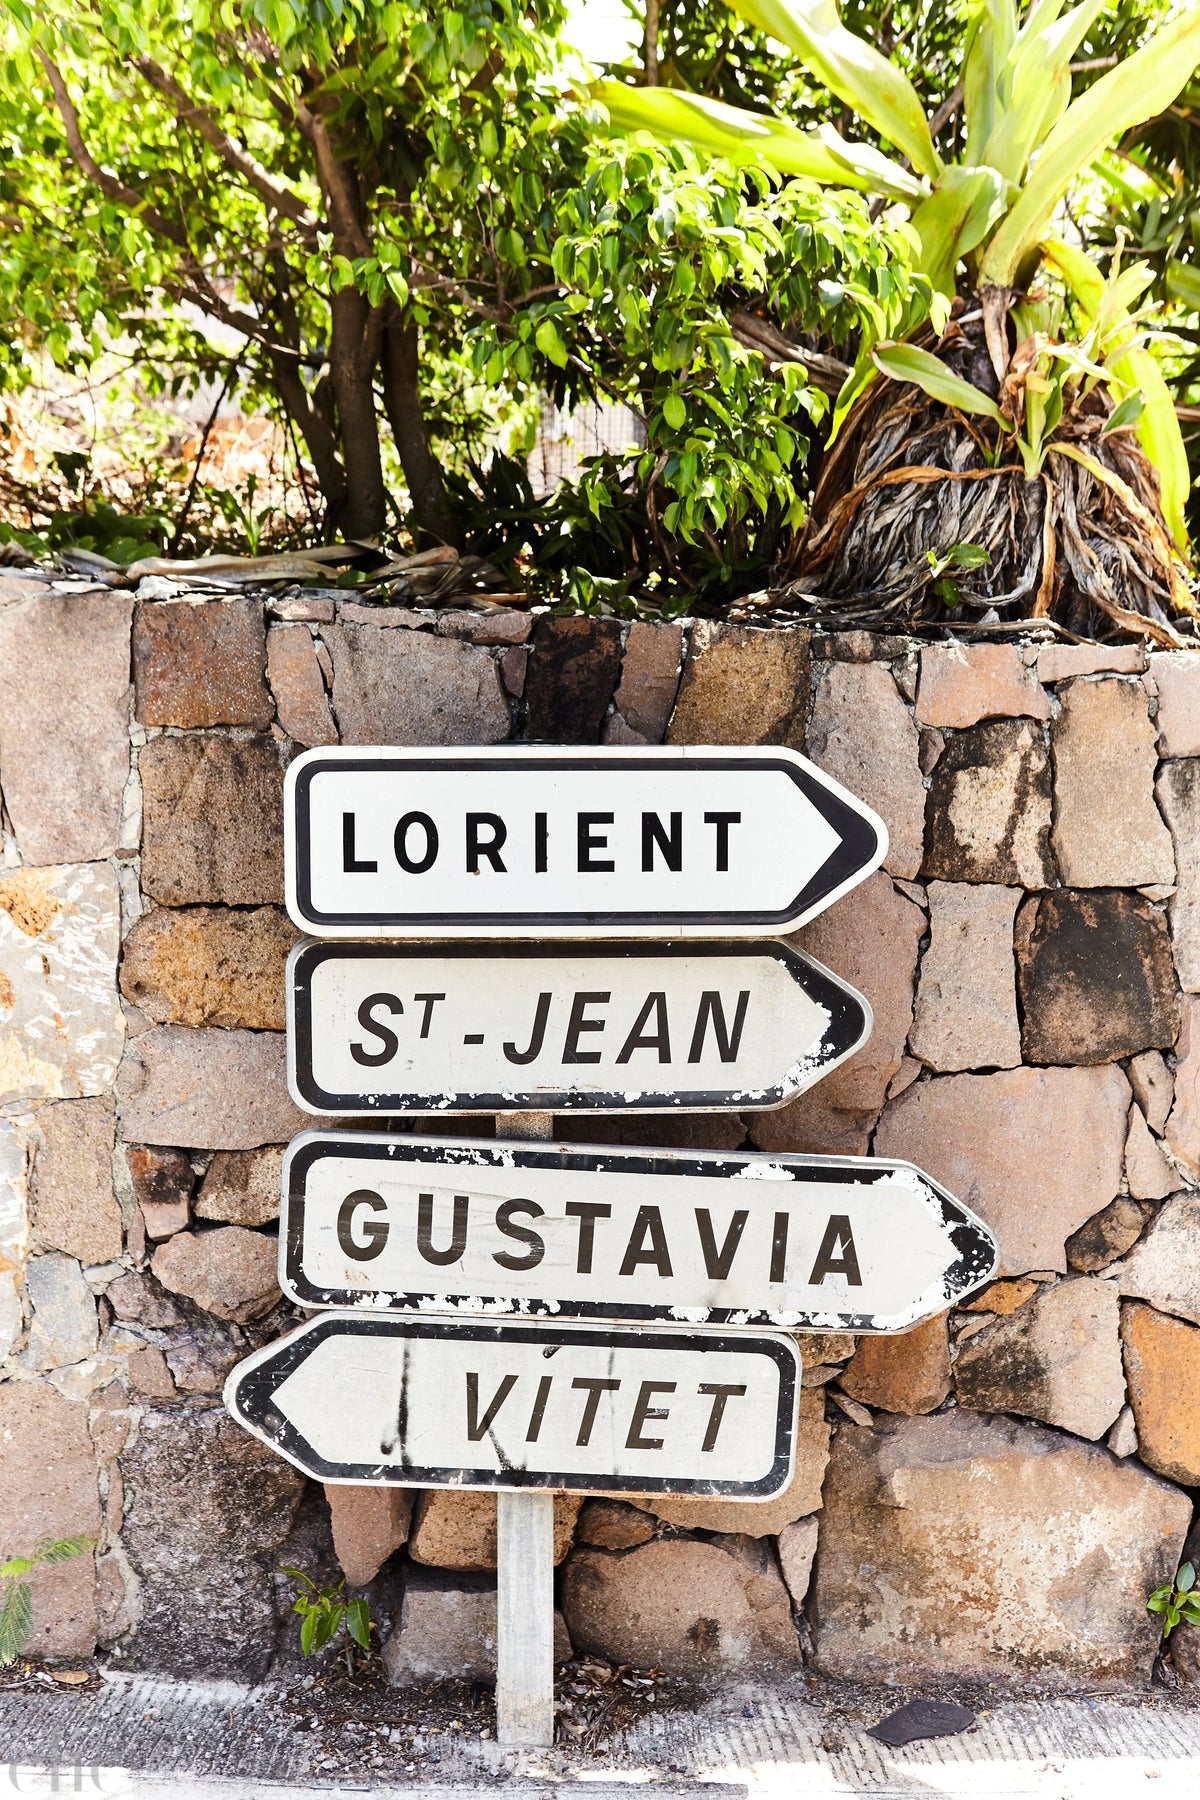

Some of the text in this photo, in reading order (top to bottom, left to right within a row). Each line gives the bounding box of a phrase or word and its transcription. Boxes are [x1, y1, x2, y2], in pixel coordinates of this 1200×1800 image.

[342, 810, 742, 875] LORIENT
[337, 1189, 864, 1287] GUSTAVIA
[466, 1372, 748, 1452] VITET
